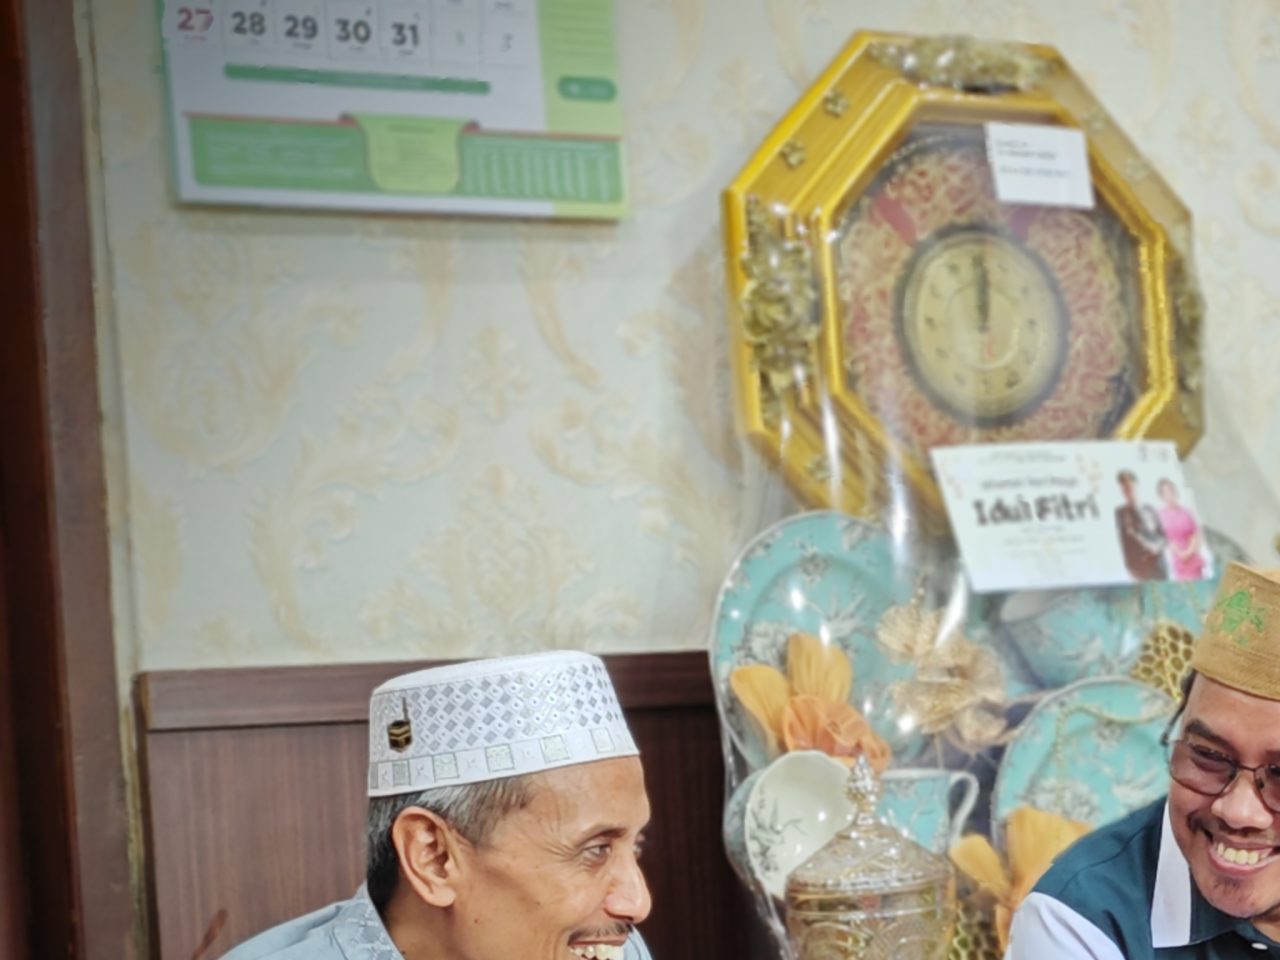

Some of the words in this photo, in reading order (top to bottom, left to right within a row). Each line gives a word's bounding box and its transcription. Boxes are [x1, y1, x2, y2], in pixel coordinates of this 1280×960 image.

[177, 7, 214, 32] 27
[232, 11, 267, 36] 28
[284, 15, 318, 40] 29
[335, 18, 371, 44] 30
[391, 22, 419, 47] 31
[974, 494, 1033, 526] Idul
[1034, 493, 1100, 521] Fitri
